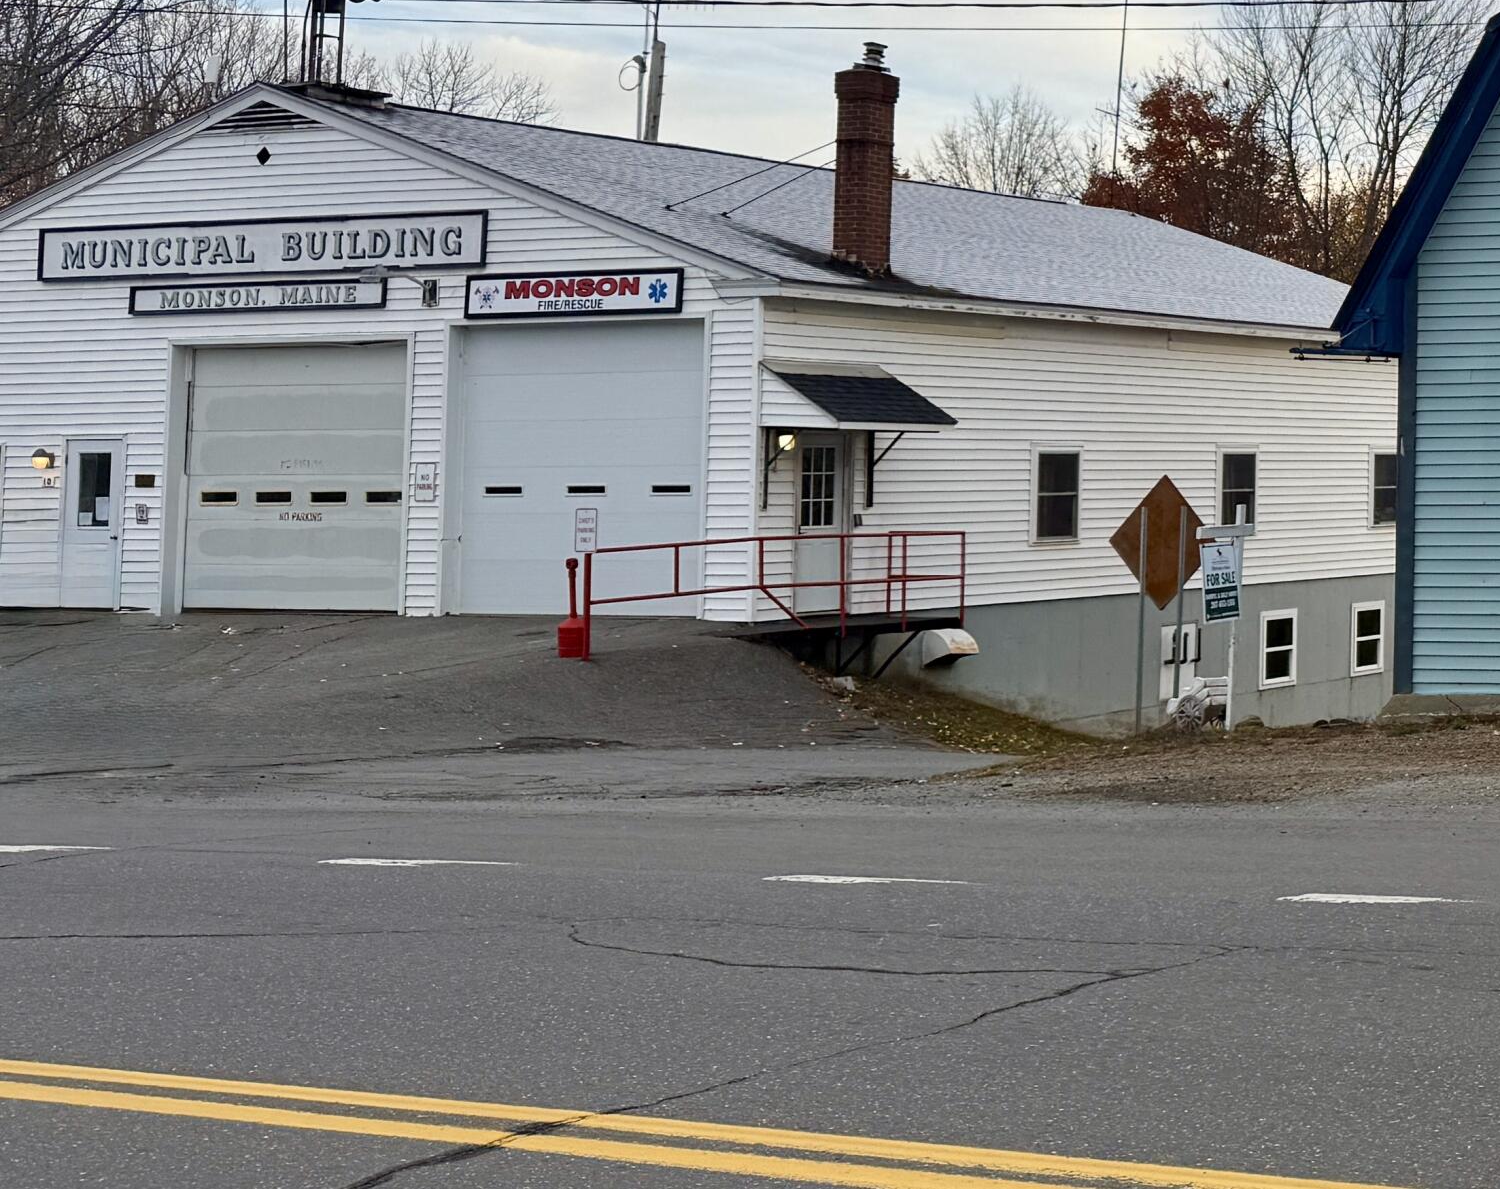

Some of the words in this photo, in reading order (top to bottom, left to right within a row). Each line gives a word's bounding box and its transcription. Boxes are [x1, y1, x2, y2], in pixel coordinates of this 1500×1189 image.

[61, 234, 255, 269] MUNICIPAL
[281, 226, 462, 261] BUILDING
[279, 285, 357, 305] MAINE
[504, 277, 640, 300] MONSON
[537, 299, 604, 311] FIRE/RESCUE
[420, 474, 430, 482] NO
[279, 512, 290, 521] NO
[291, 512, 323, 522] PARKING
[1206, 573, 1220, 586] FOR
[1221, 571, 1236, 584] SALE
